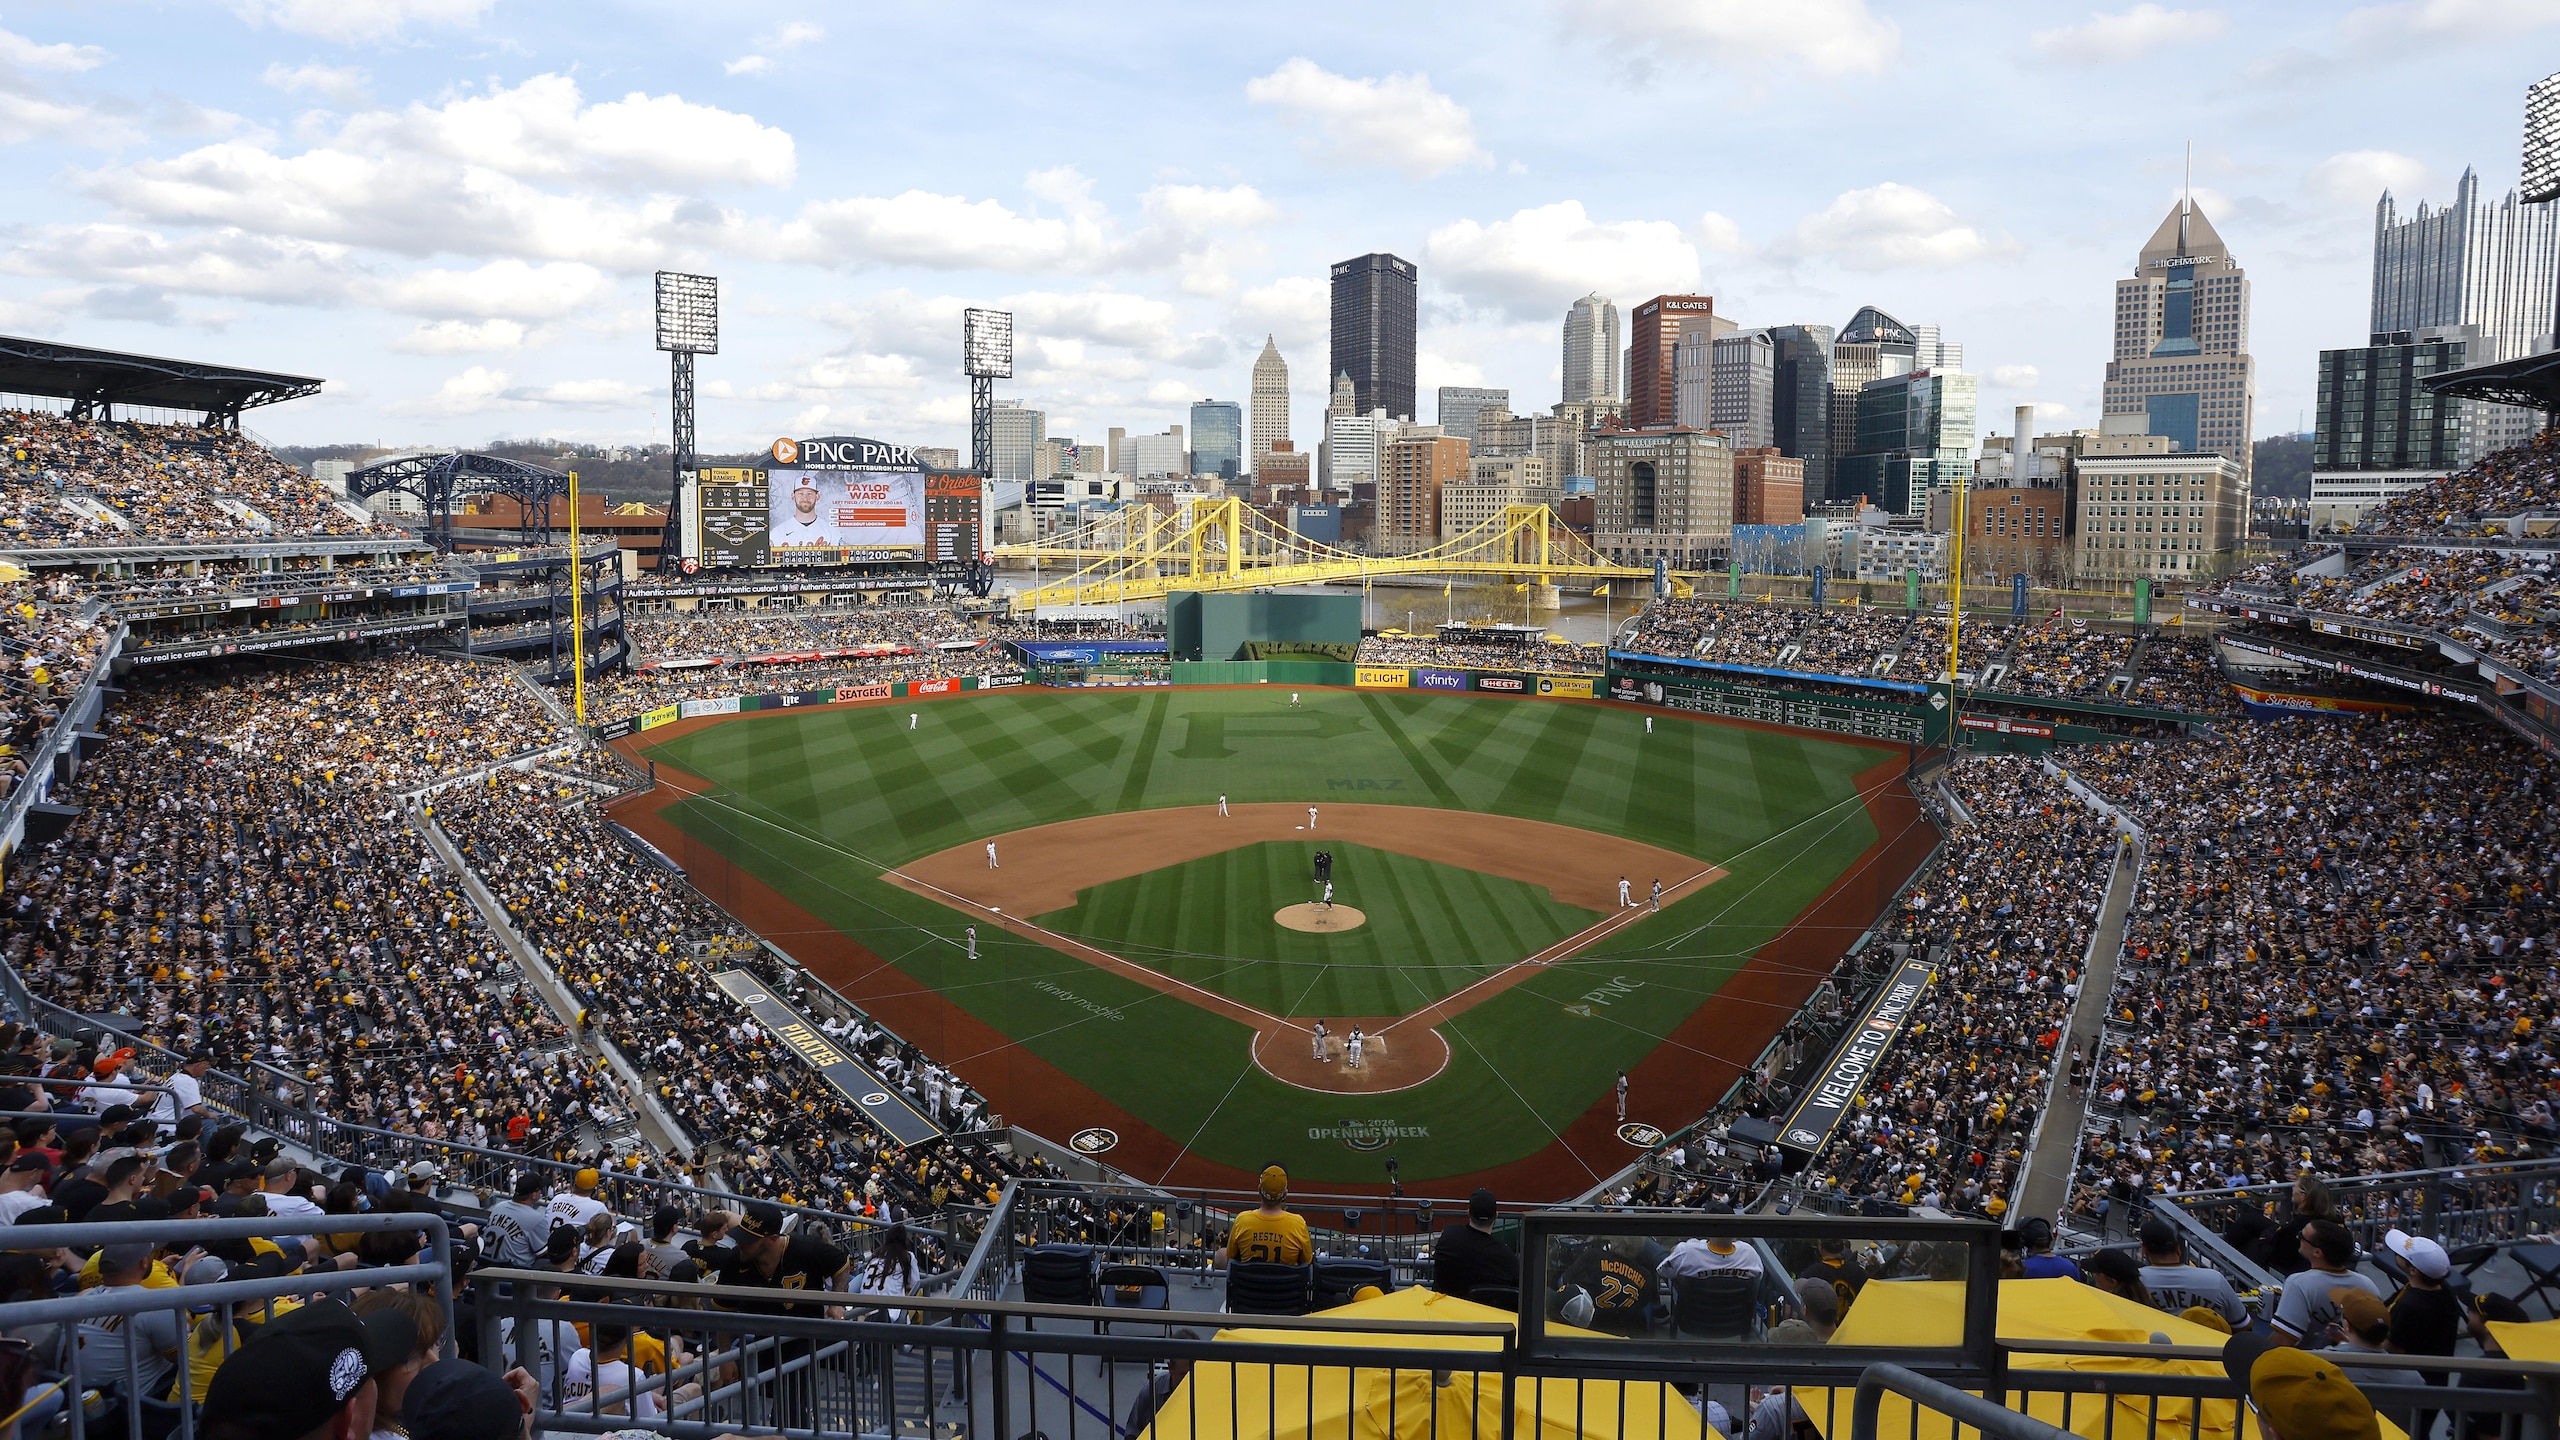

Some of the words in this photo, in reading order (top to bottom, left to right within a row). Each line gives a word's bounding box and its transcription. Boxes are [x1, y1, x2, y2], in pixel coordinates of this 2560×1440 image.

[1392, 259, 1407, 273] UPMC
[2155, 255, 2213, 268] HIGHMARK
[1666, 301, 1681, 309] K&L
[1682, 302, 1708, 310] GATES
[802, 441, 855, 463] PNC
[860, 444, 920, 465] PARK
[700, 469, 711, 480] 49
[851, 464, 892, 472] PITTSBURGH
[756, 472, 766, 485] P
[939, 474, 981, 490] Orioles
[846, 484, 890, 492] TAYLOR
[850, 492, 886, 500] WARD
[868, 551, 889, 560] 200
[717, 585, 751, 594] Authentic
[752, 584, 779, 593] custard
[800, 582, 831, 592] Authentic
[831, 582, 856, 591] custard
[876, 580, 904, 589] Authentic
[905, 579, 928, 588] custard
[628, 588, 664, 598] Authentic
[666, 587, 694, 597] custard
[279, 597, 300, 606] WARD
[322, 594, 332, 602] 0-1
[220, 603, 226, 611] 5
[360, 630, 383, 638] Cravings
[422, 622, 437, 631] cream
[1496, 623, 1513, 631] TIME
[240, 642, 268, 652] Cravings
[269, 640, 282, 649] call
[282, 640, 292, 648] for
[293, 638, 306, 646] real
[306, 636, 316, 644] ice
[316, 635, 336, 644] cream
[140, 656, 152, 664] for
[154, 654, 169, 662] real
[184, 650, 208, 659] cream
[990, 675, 1023, 686] BETMGM
[1360, 673, 1372, 683] IC
[1374, 674, 1405, 684] LIGHT
[1423, 674, 1460, 688] xfinity
[1481, 679, 1522, 688] SHEETZ
[2351, 666, 2370, 678] Cravings
[2370, 672, 2378, 680] call
[2378, 673, 2386, 682] for
[2386, 674, 2396, 684] real
[2396, 678, 2404, 686] ice
[2404, 680, 2420, 690] cream
[919, 678, 950, 694] Coca-Cola
[1680, 683, 1725, 692] NATIONAL
[1732, 690, 1768, 698] LEAGUE
[839, 686, 888, 701] SEATGEEK
[1618, 693, 1636, 702] custard
[1622, 688, 1644, 698] premium
[2442, 688, 2466, 701] Cravings
[2467, 694, 2478, 704] call
[724, 699, 738, 710] 125
[782, 695, 800, 707] Lite
[1802, 699, 1856, 710] AMERICAN
[1864, 707, 1906, 716] LEAGUE
[2264, 693, 2313, 709] Surfside
[651, 714, 662, 724] PLAY
[1325, 778, 1408, 791] MAZ
[1908, 963, 1930, 972] P
[1580, 975, 1646, 1006] PNC
[1888, 982, 1918, 1004] PARK
[1031, 979, 1079, 1001] xfinity
[1073, 997, 1125, 1022] mobile
[1876, 1001, 1905, 1022] PNC
[1862, 1029, 1886, 1046] TO
[778, 1022, 844, 1068] PIRATES
[1813, 1045, 1877, 1109] WELCOME
[872, 1094, 882, 1104] P
[1368, 1119, 1396, 1128] 2026
[1308, 1127, 1381, 1140] OPENING
[1383, 1126, 1430, 1138] WEEK
[552, 1202, 580, 1219] GRIFFIN
[1253, 1232, 1284, 1242] RESTLY
[482, 1230, 504, 1259] 21
[1600, 1259, 1646, 1289] McCUTCHEN
